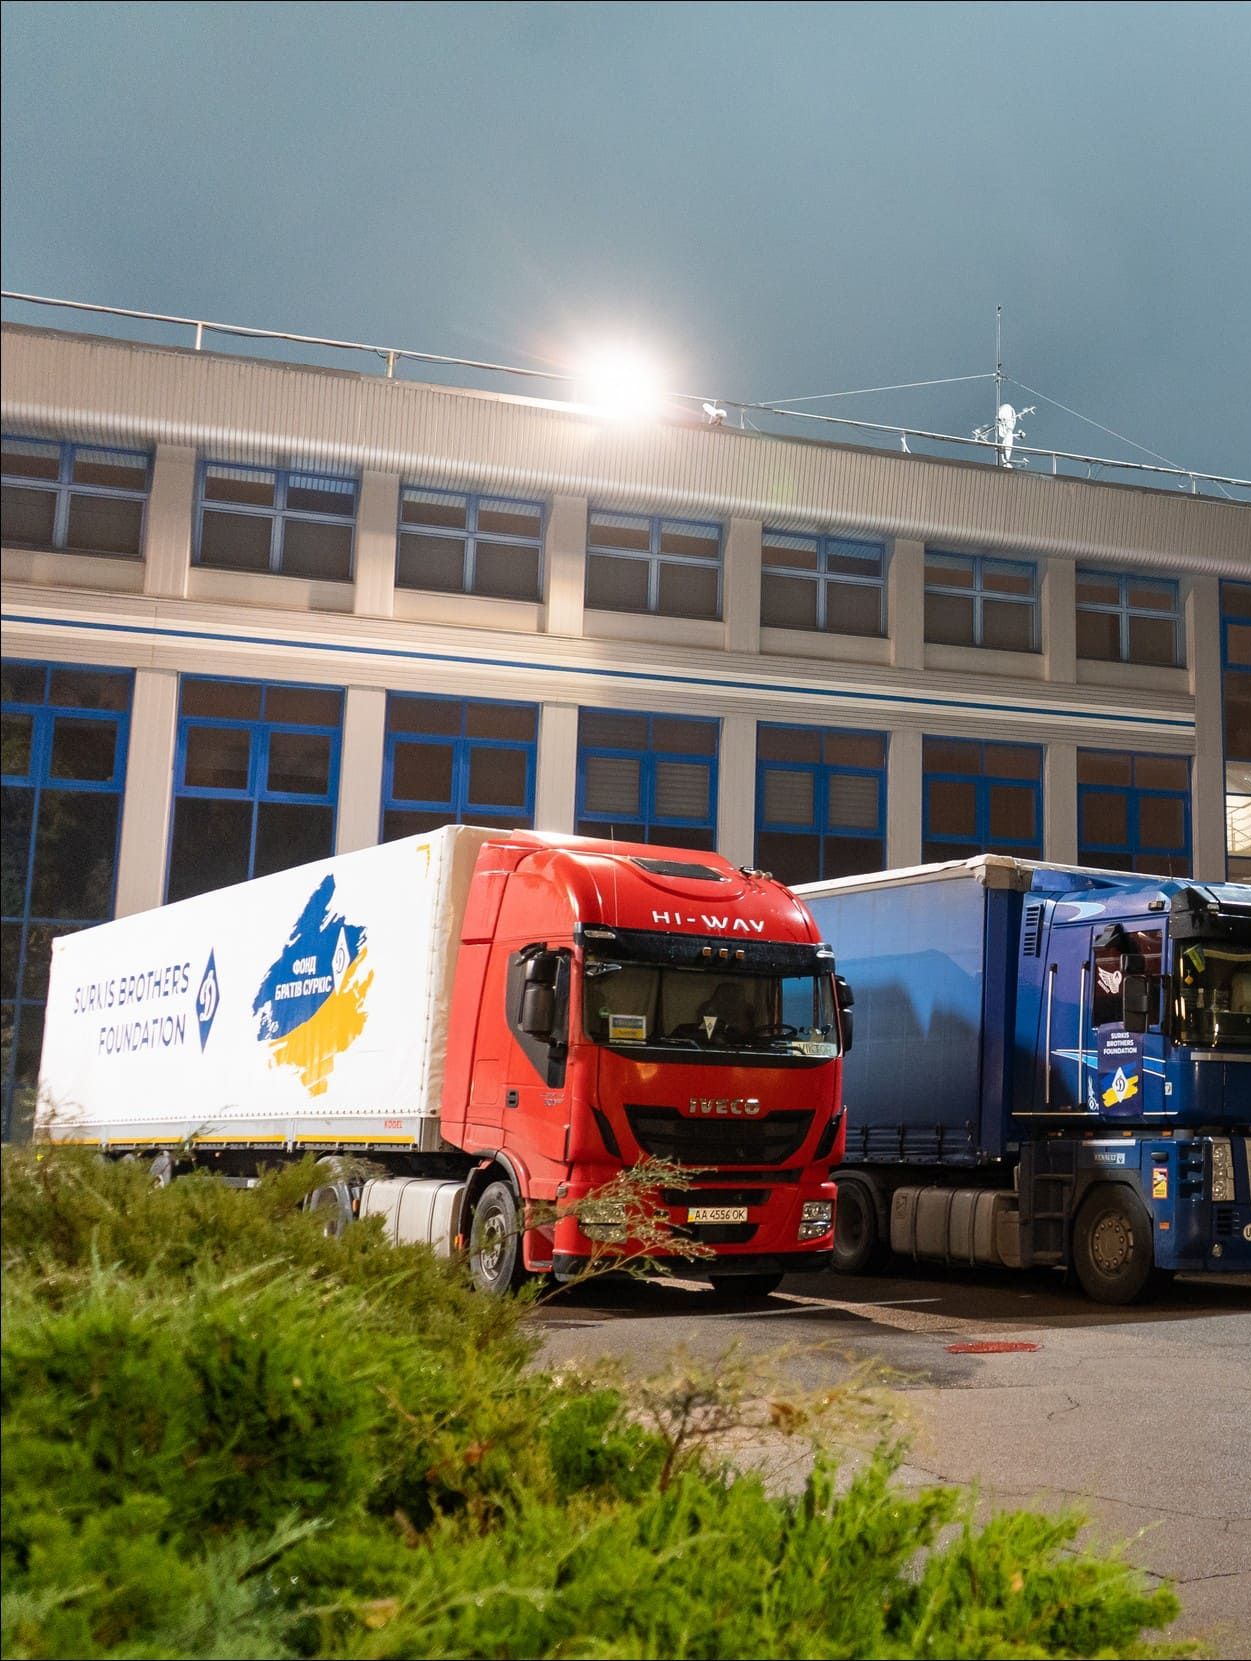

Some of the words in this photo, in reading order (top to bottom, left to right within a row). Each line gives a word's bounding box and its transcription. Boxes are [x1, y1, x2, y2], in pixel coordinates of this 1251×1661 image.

[651, 910, 765, 933] HI-WAY
[292, 955, 317, 975] ФОНД
[74, 979, 116, 1015] SURKIS
[117, 961, 191, 1006] BROTHERS
[98, 1012, 187, 1056] FOUNDATION
[1106, 1039, 1134, 1047] BROTHERS
[1103, 1047, 1138, 1055] FOUNDATION
[689, 1097, 760, 1115] IVECO
[695, 1210, 708, 1220] AA
[709, 1210, 731, 1220] 4556
[732, 1210, 745, 1220] OK
